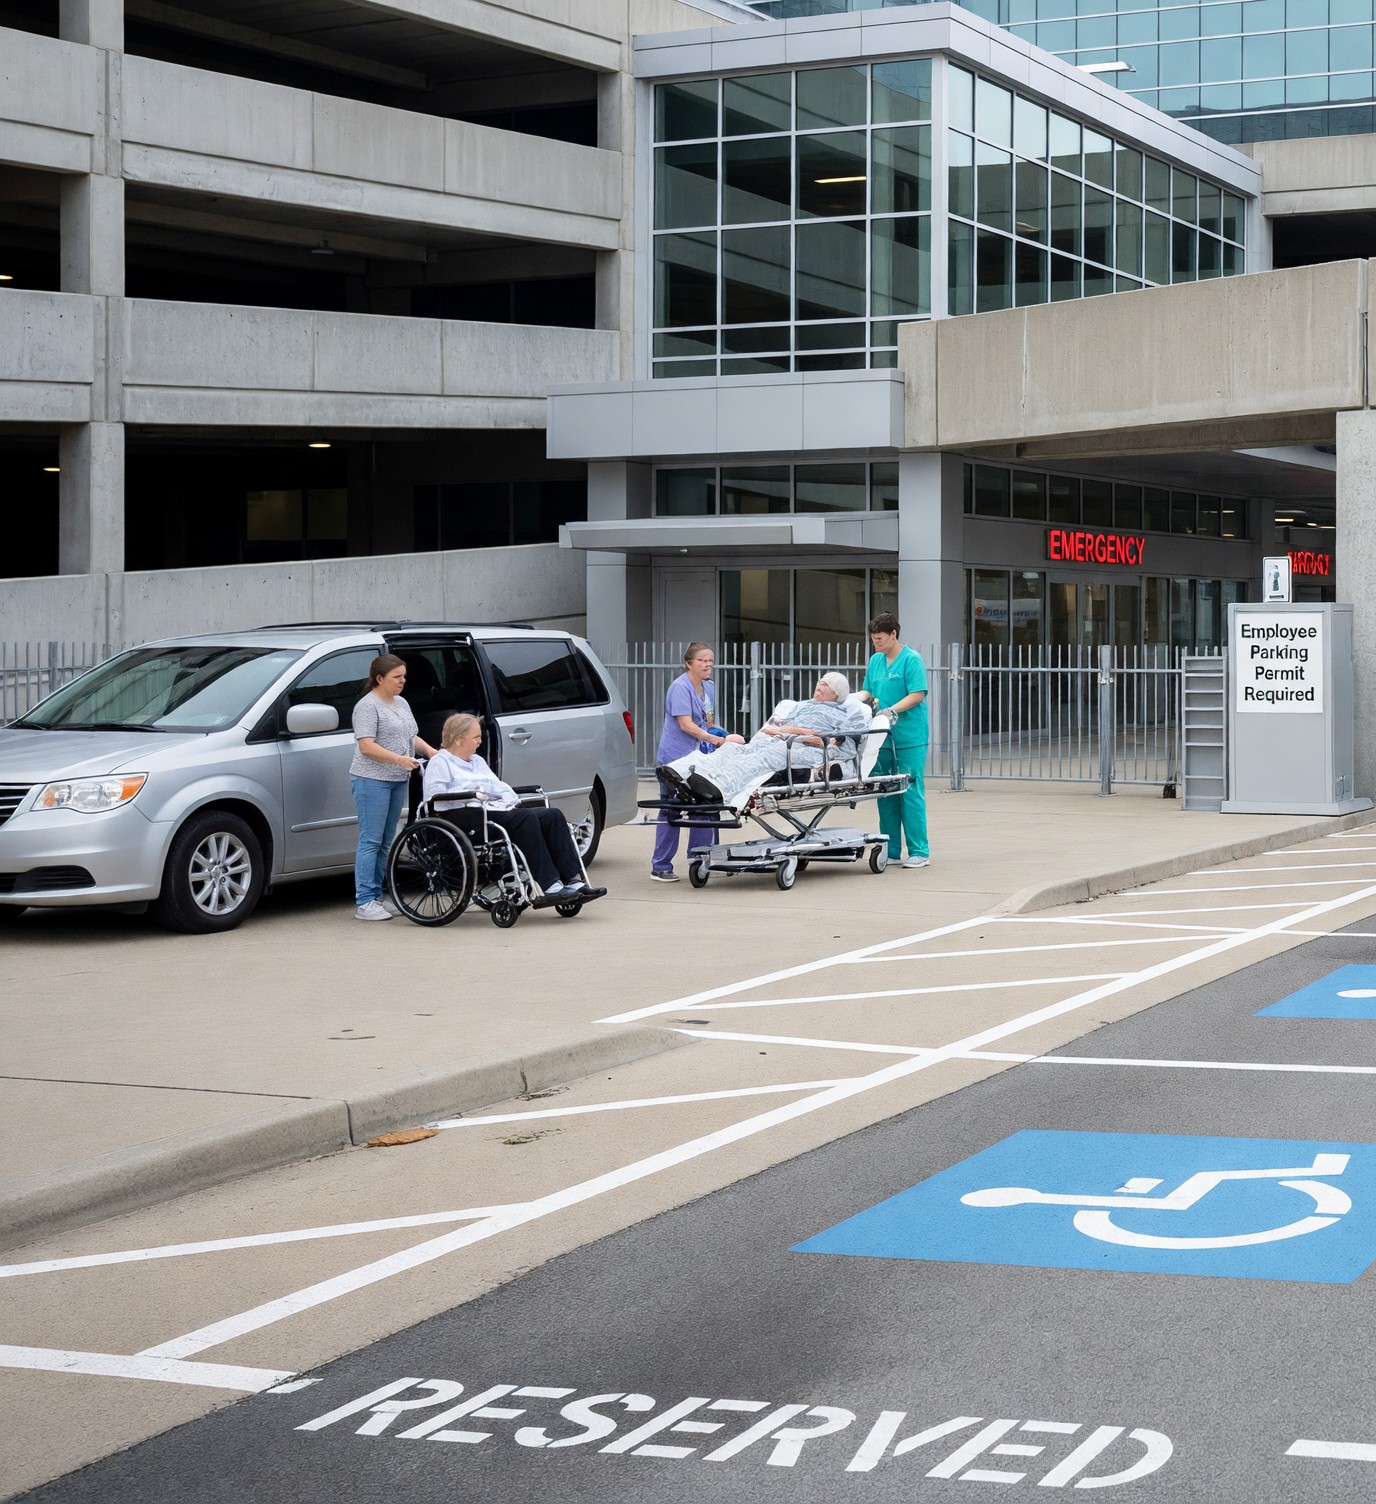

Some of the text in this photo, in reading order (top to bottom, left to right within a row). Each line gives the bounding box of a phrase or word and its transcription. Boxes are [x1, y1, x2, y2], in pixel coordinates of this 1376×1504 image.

[1050, 529, 1145, 565] EMERGENCY
[1241, 623, 1317, 642] Employee
[1250, 644, 1309, 663] Parking
[1255, 665, 1305, 681] Permit
[1244, 686, 1315, 705] Required
[294, 1376, 1174, 1490] RESERVED
